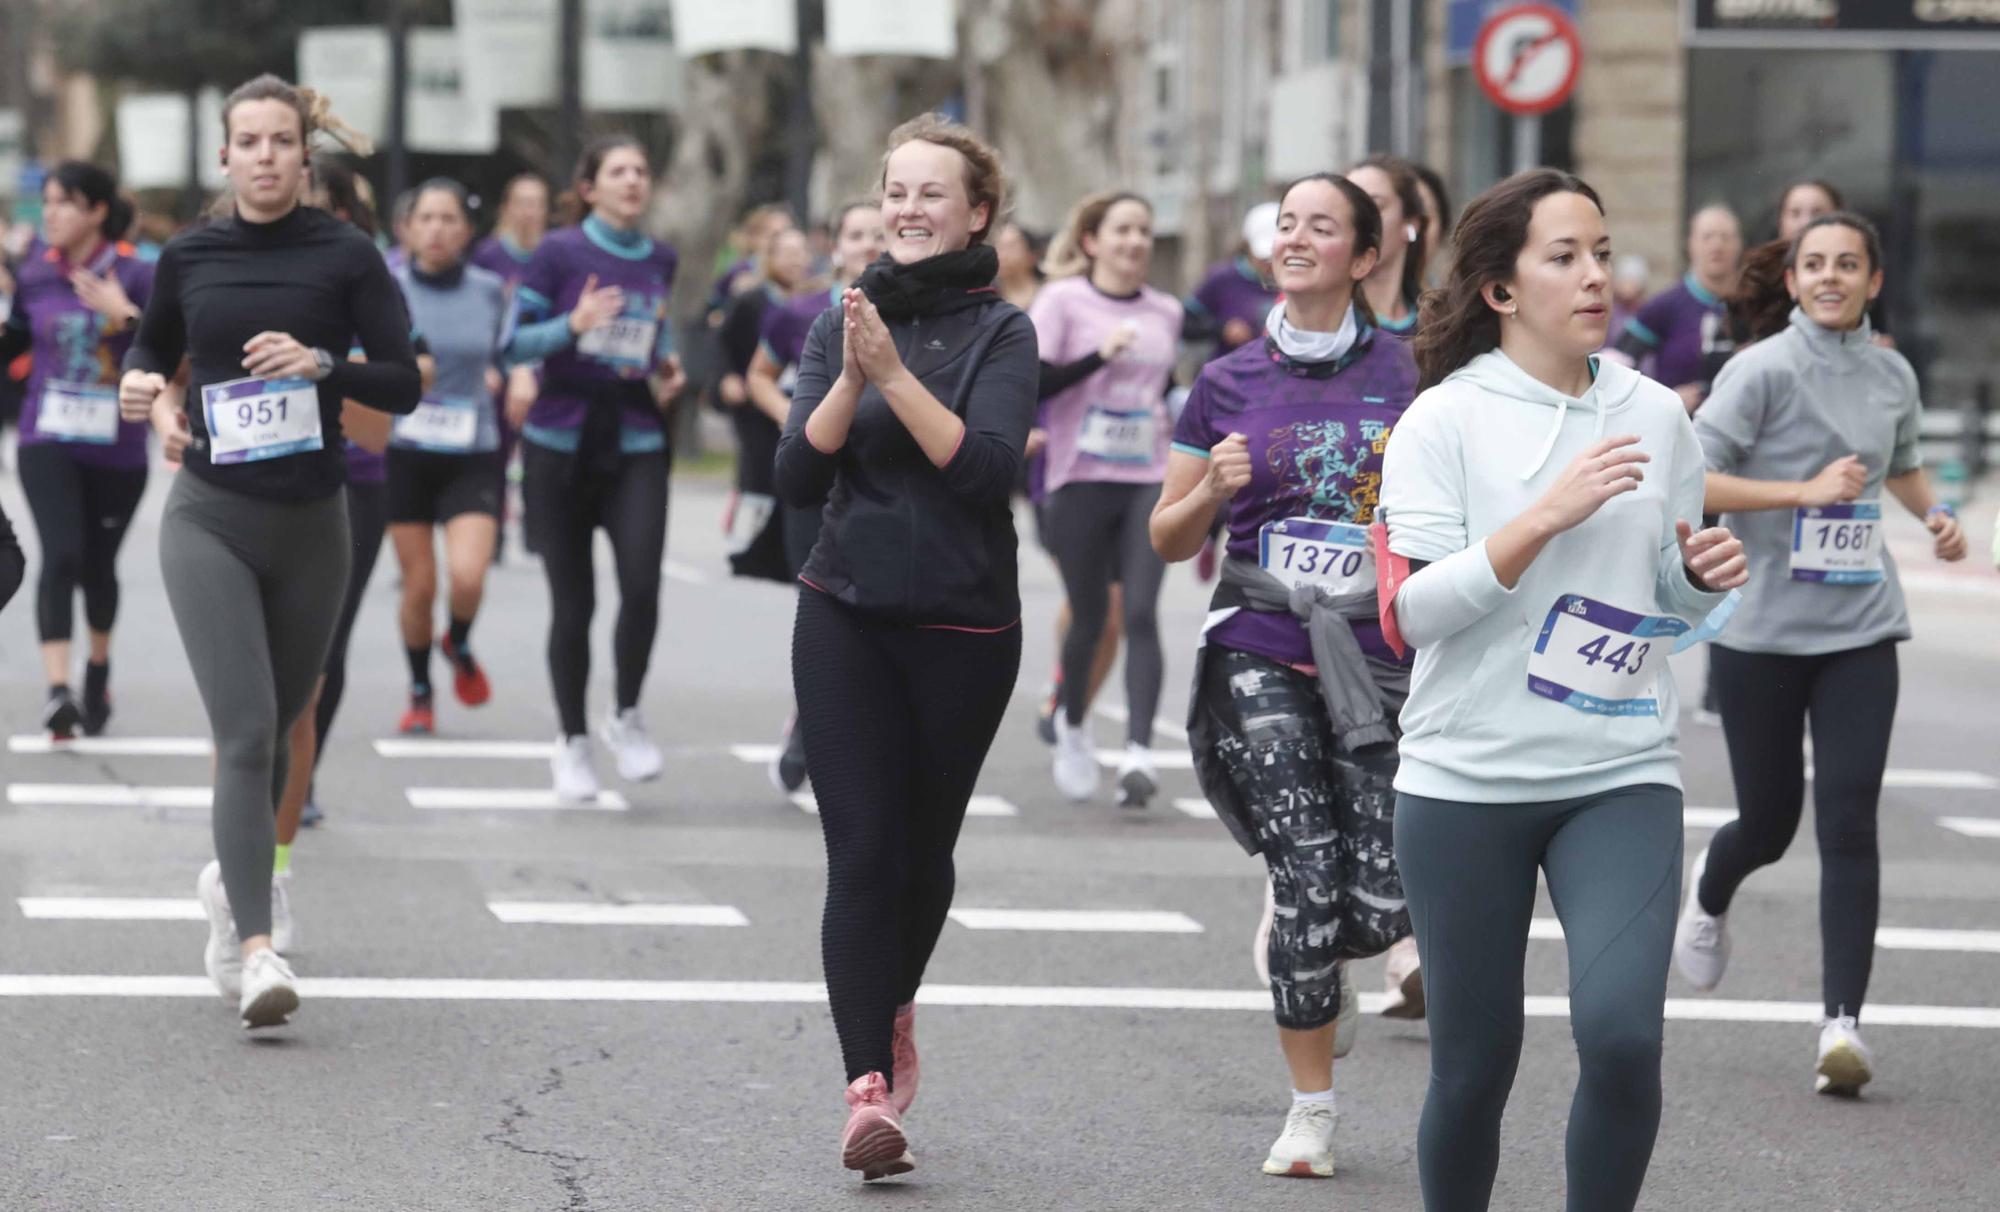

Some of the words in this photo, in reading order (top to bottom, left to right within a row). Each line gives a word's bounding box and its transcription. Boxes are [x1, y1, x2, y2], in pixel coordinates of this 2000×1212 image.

[238, 397, 288, 429] 951
[1816, 523, 1873, 550] 1687
[1282, 542, 1363, 577] 1370
[1577, 634, 1651, 675] 443
